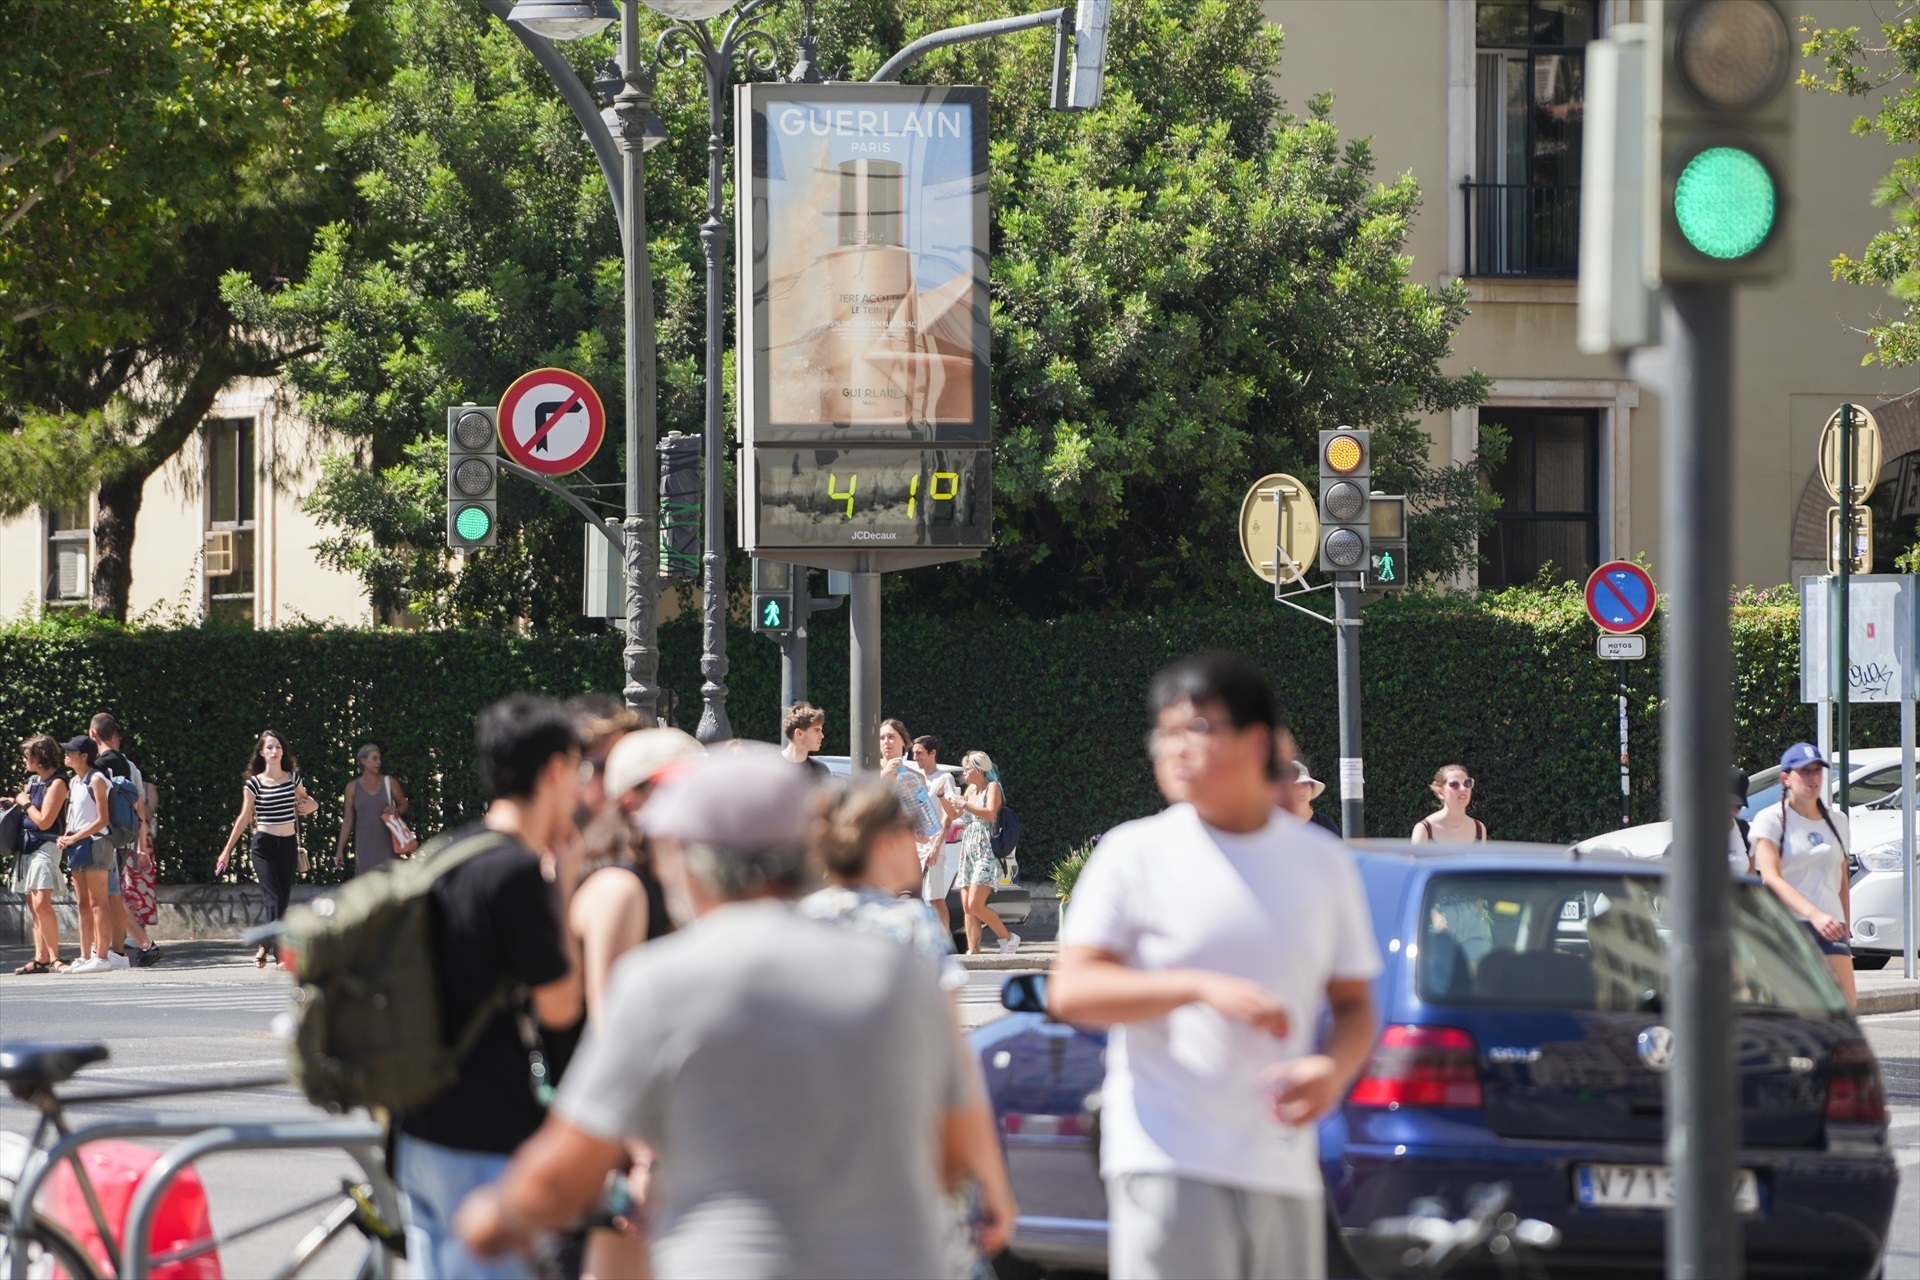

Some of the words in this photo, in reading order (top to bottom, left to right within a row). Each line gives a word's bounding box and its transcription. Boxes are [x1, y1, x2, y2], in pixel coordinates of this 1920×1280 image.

[779, 108, 961, 138] GUERLAIN
[851, 142, 891, 153] PARIS
[851, 531, 897, 540] JCDecaux
